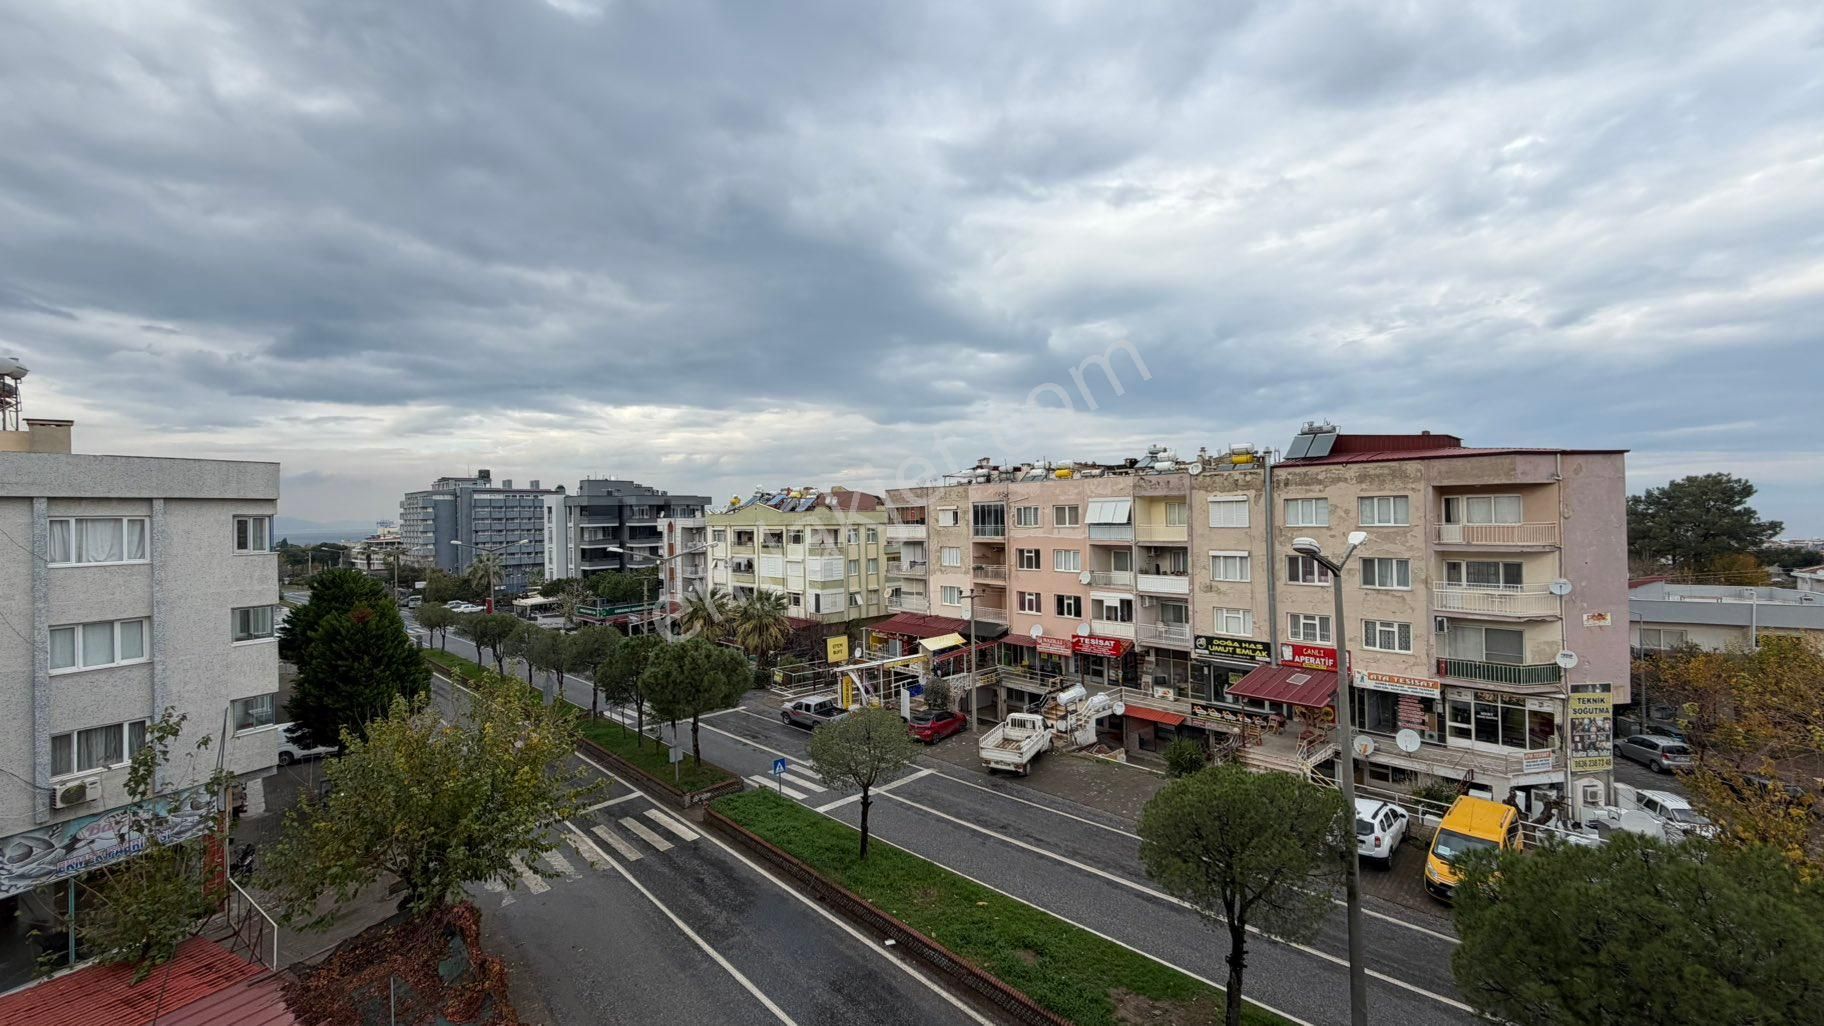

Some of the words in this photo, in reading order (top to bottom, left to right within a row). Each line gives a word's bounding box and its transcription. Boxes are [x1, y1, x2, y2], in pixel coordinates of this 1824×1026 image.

[1079, 637, 1115, 647] TESİSAT
[1208, 645, 1234, 653] UMUT
[1235, 648, 1268, 657] EMLAK
[1302, 648, 1324, 656] CANLI
[1294, 655, 1334, 666] APERATİF
[1369, 674, 1389, 682] ATA
[1572, 706, 1610, 715] SOĞUTMA
